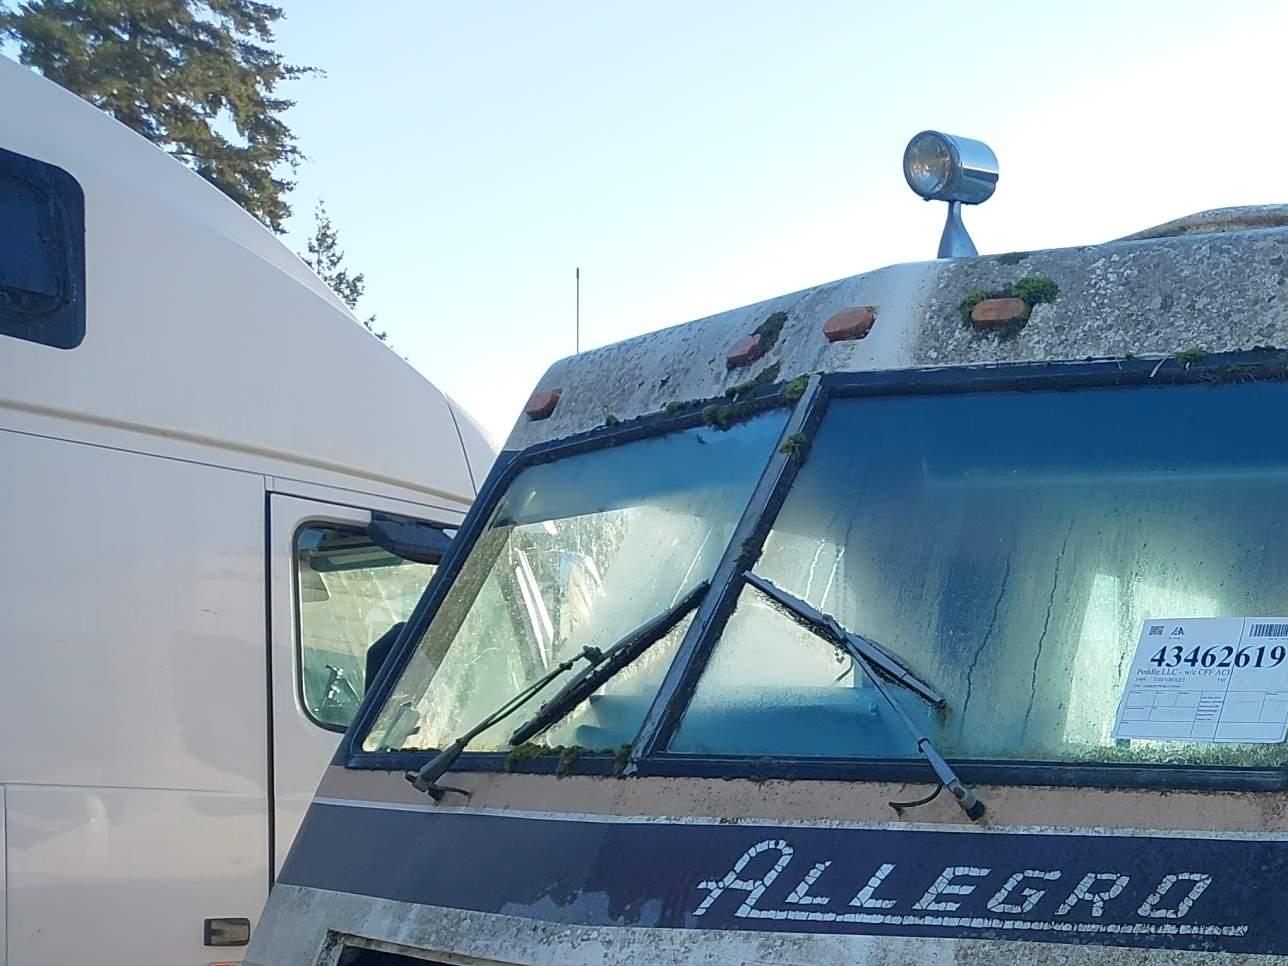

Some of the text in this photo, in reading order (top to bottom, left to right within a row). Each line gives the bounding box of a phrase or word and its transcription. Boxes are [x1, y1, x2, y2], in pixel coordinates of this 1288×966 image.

[1150, 645, 1287, 668] 43462619
[1161, 668, 1177, 676] LLC
[693, 838, 1214, 919] ALLEGRO
